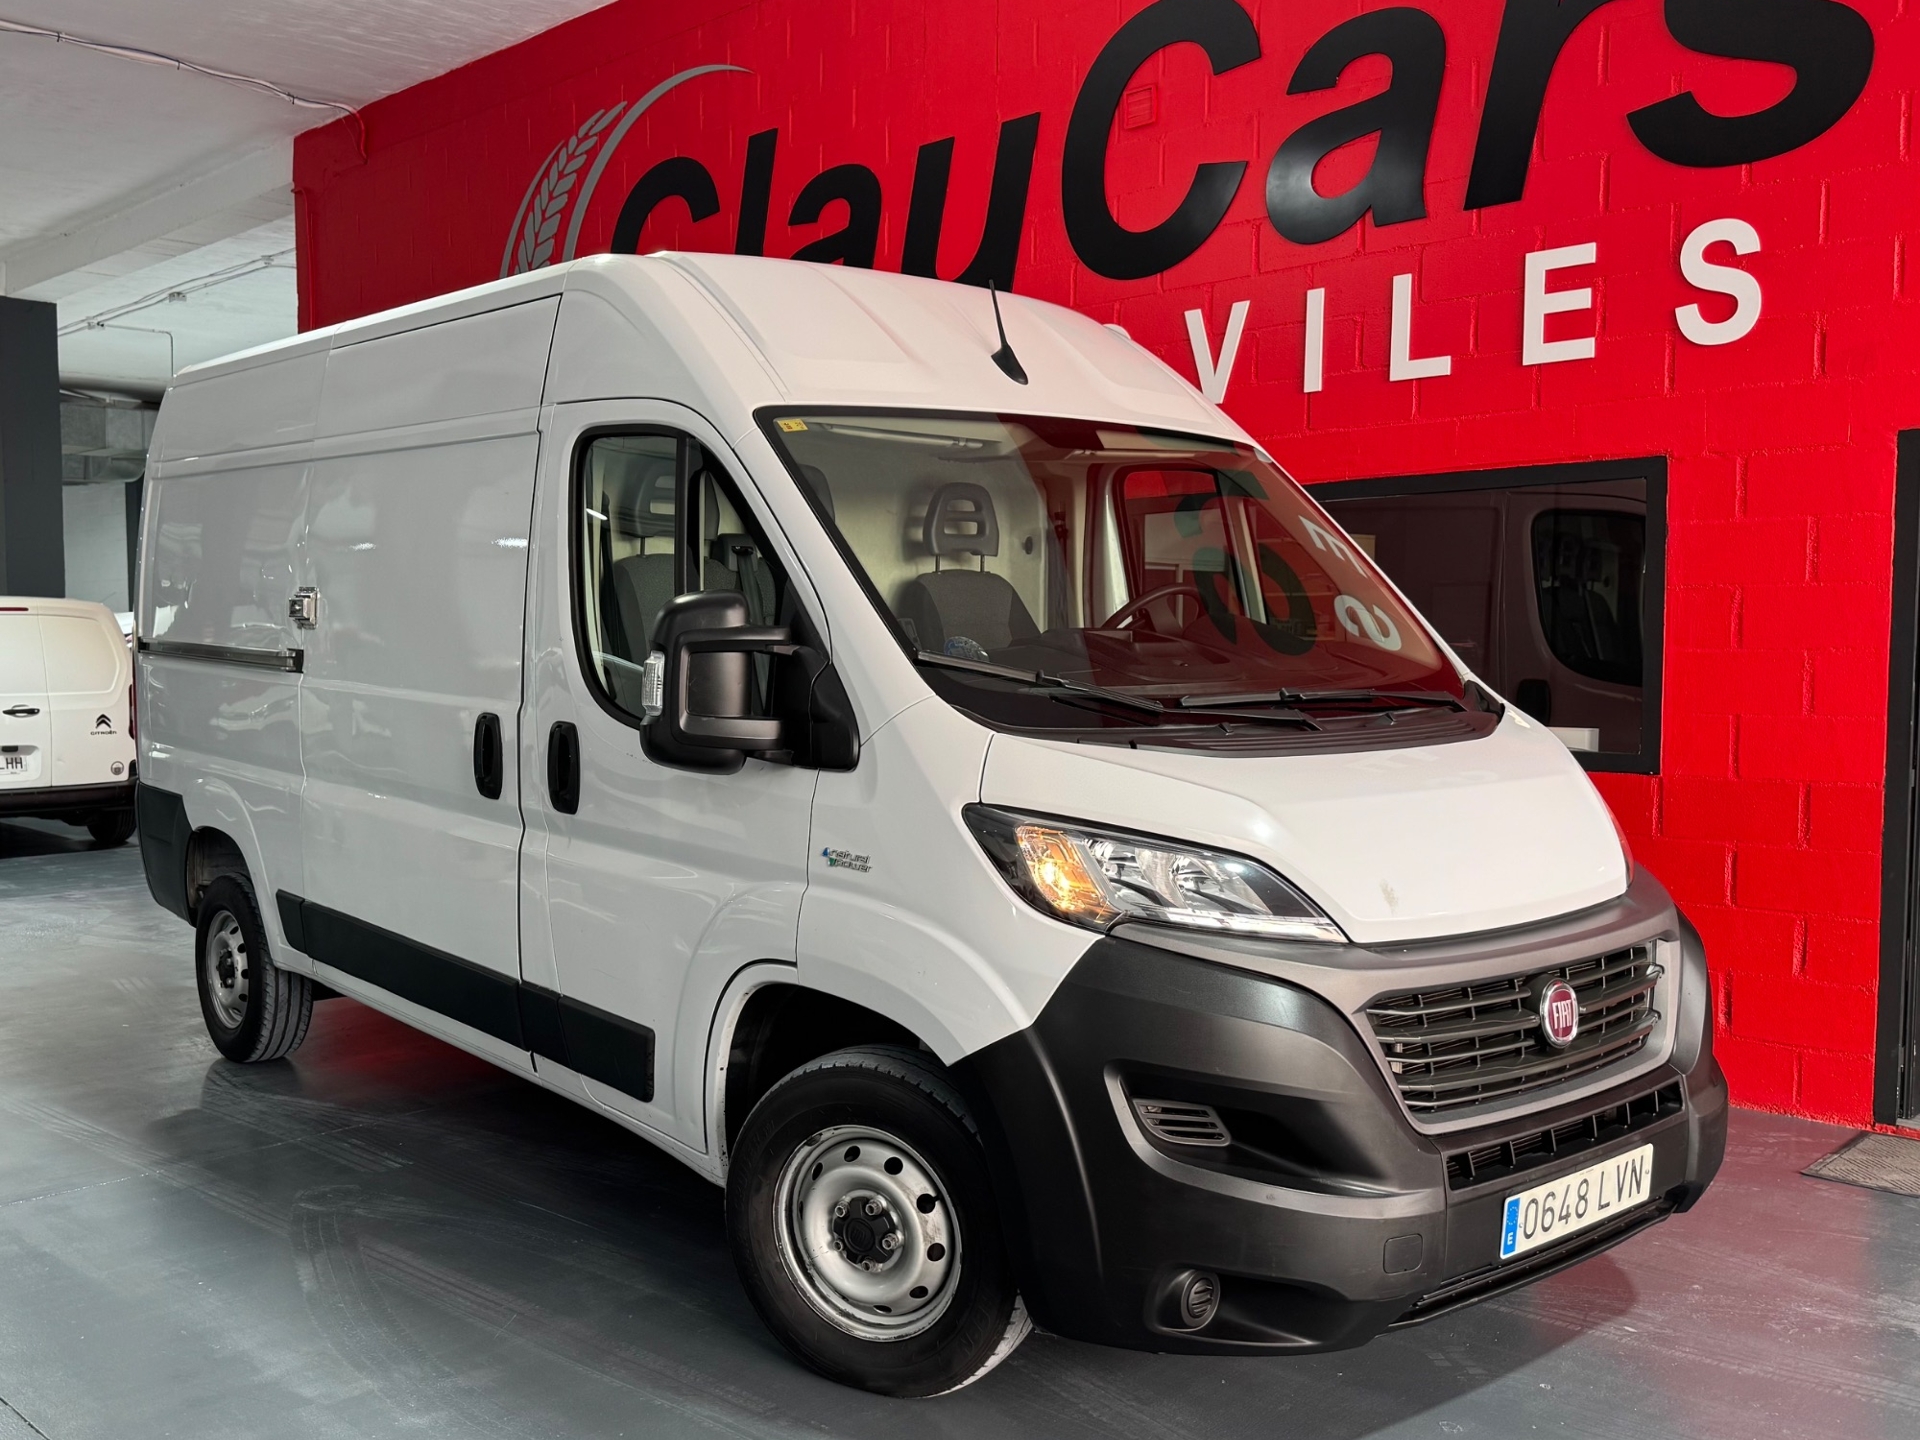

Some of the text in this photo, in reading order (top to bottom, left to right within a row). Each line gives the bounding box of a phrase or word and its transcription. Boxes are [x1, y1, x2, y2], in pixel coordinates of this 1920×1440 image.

[1103, 218, 1763, 404] VILES
[1552, 999, 1572, 1030] FIAT
[1523, 1154, 1644, 1240] 0648 LVN
[1507, 1232, 1514, 1245] E
